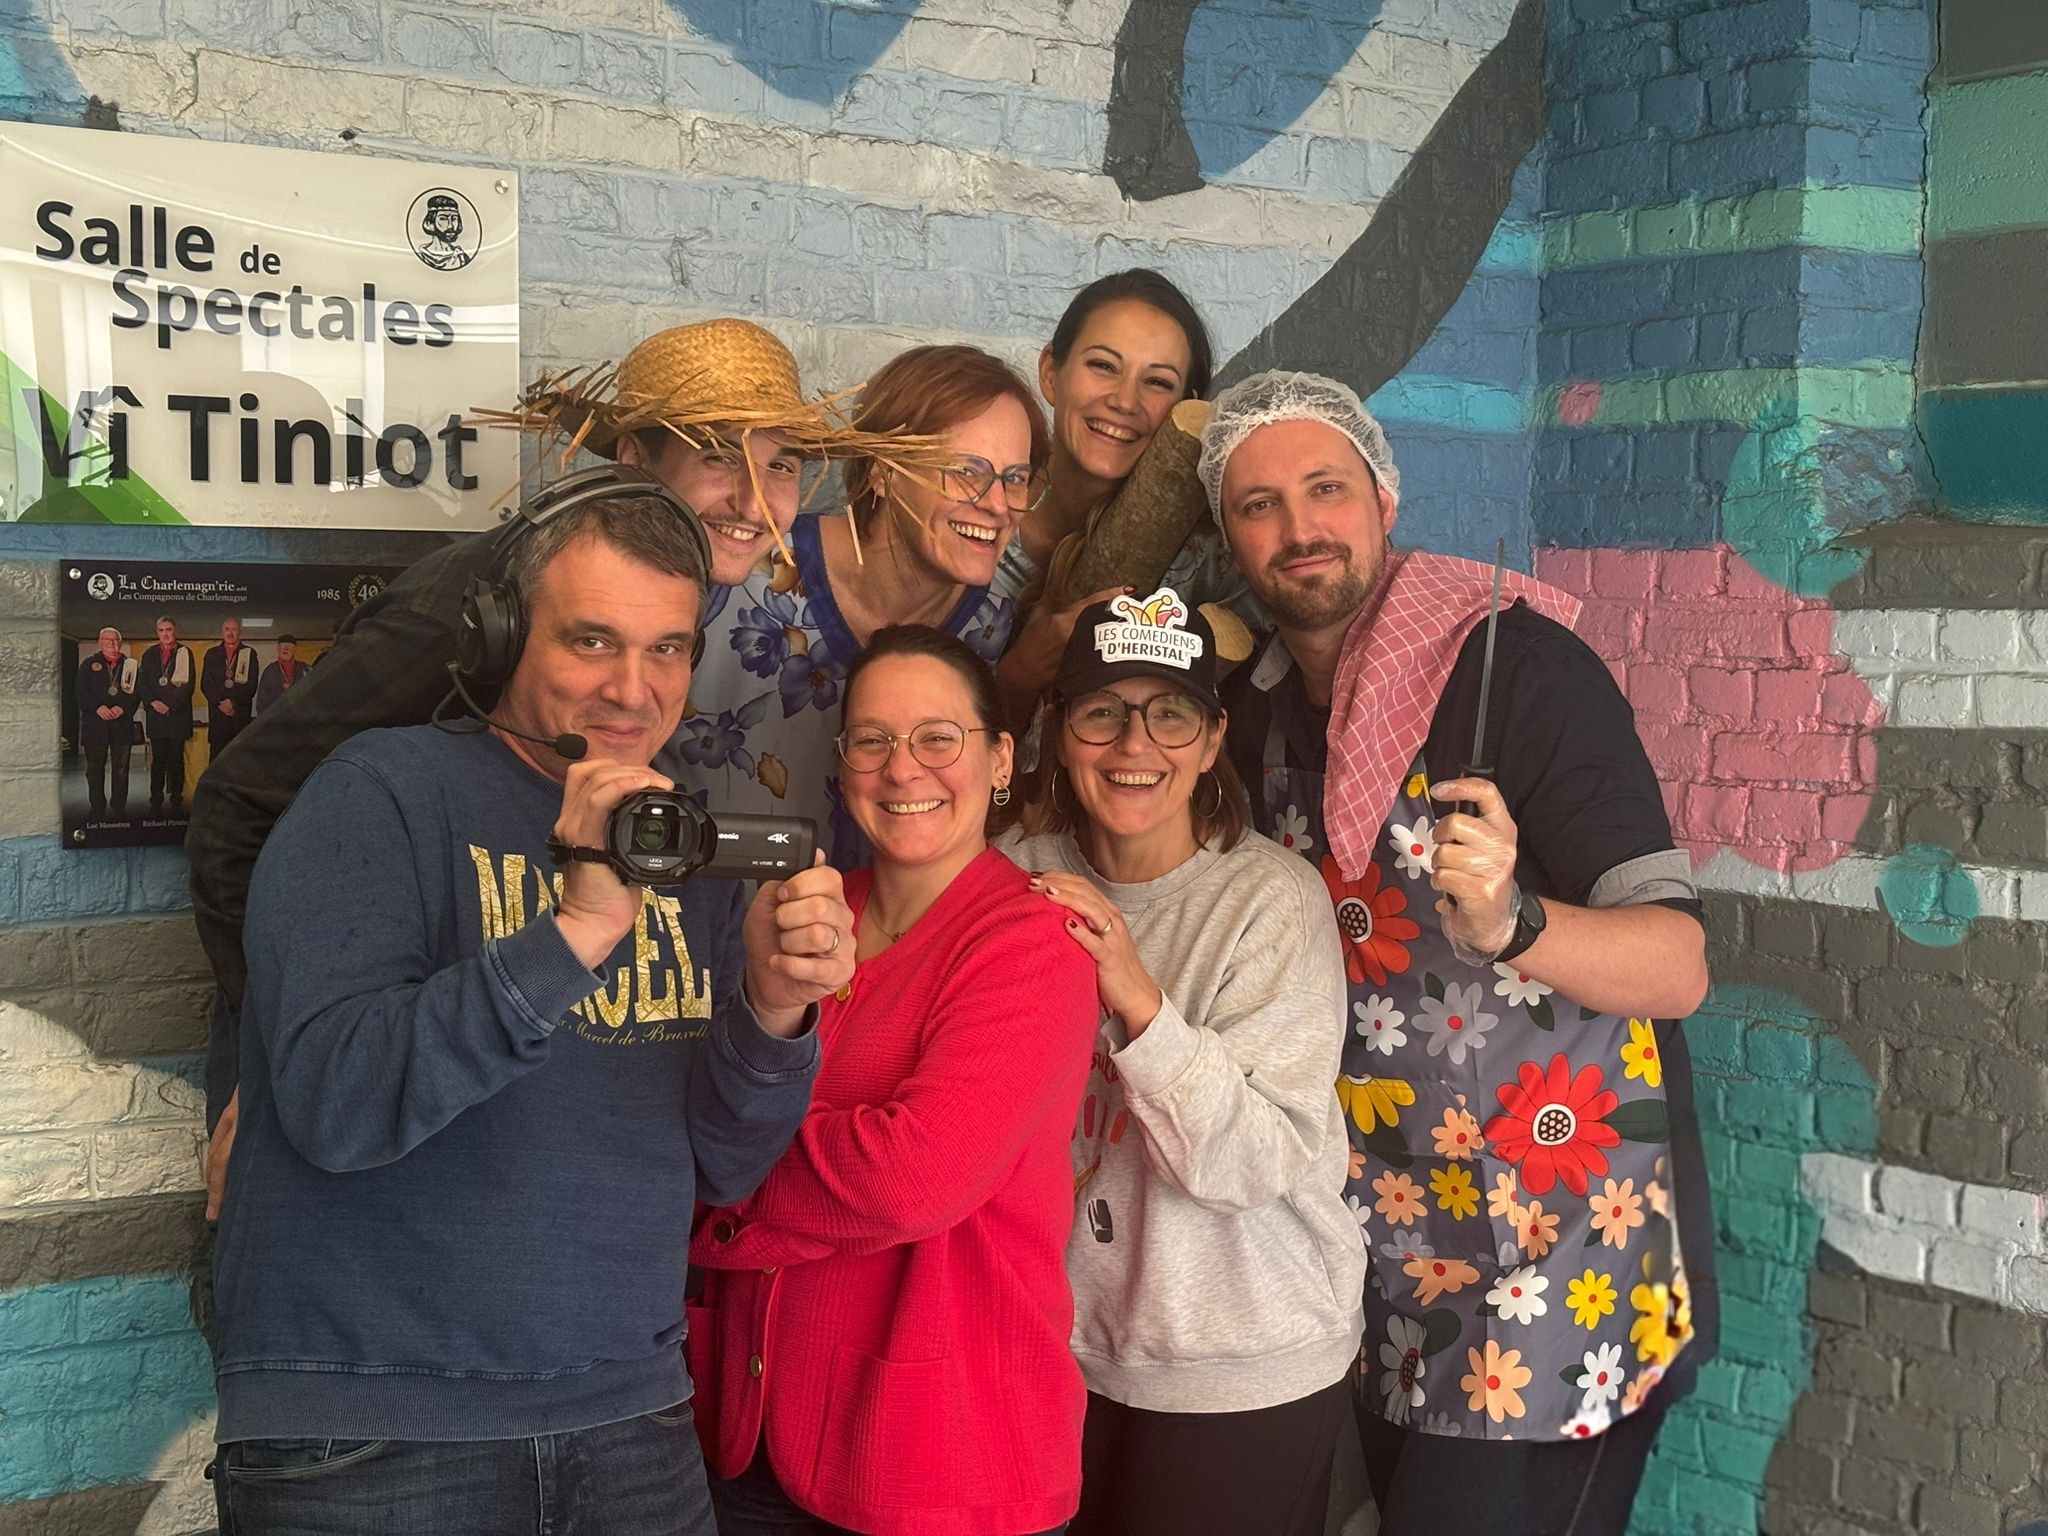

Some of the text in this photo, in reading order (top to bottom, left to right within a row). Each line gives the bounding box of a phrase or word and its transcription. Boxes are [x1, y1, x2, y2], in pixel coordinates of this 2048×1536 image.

[35, 200, 281, 275] Salle de
[111, 268, 455, 349] Spectales
[22, 386, 480, 491] Vî Tinlot
[117, 574, 138, 591] La
[141, 575, 235, 593] Charlemagn'rie
[317, 584, 379, 601] 1985 40
[118, 592, 248, 604] Les Compagnons de Charlemagne
[1098, 627, 1196, 651] LES COMEDIENS
[1107, 642, 1185, 662] D'HERISTAL
[767, 833, 790, 844] 4K
[618, 1029, 637, 1047] de
[641, 1022, 709, 1045] Bruxell
